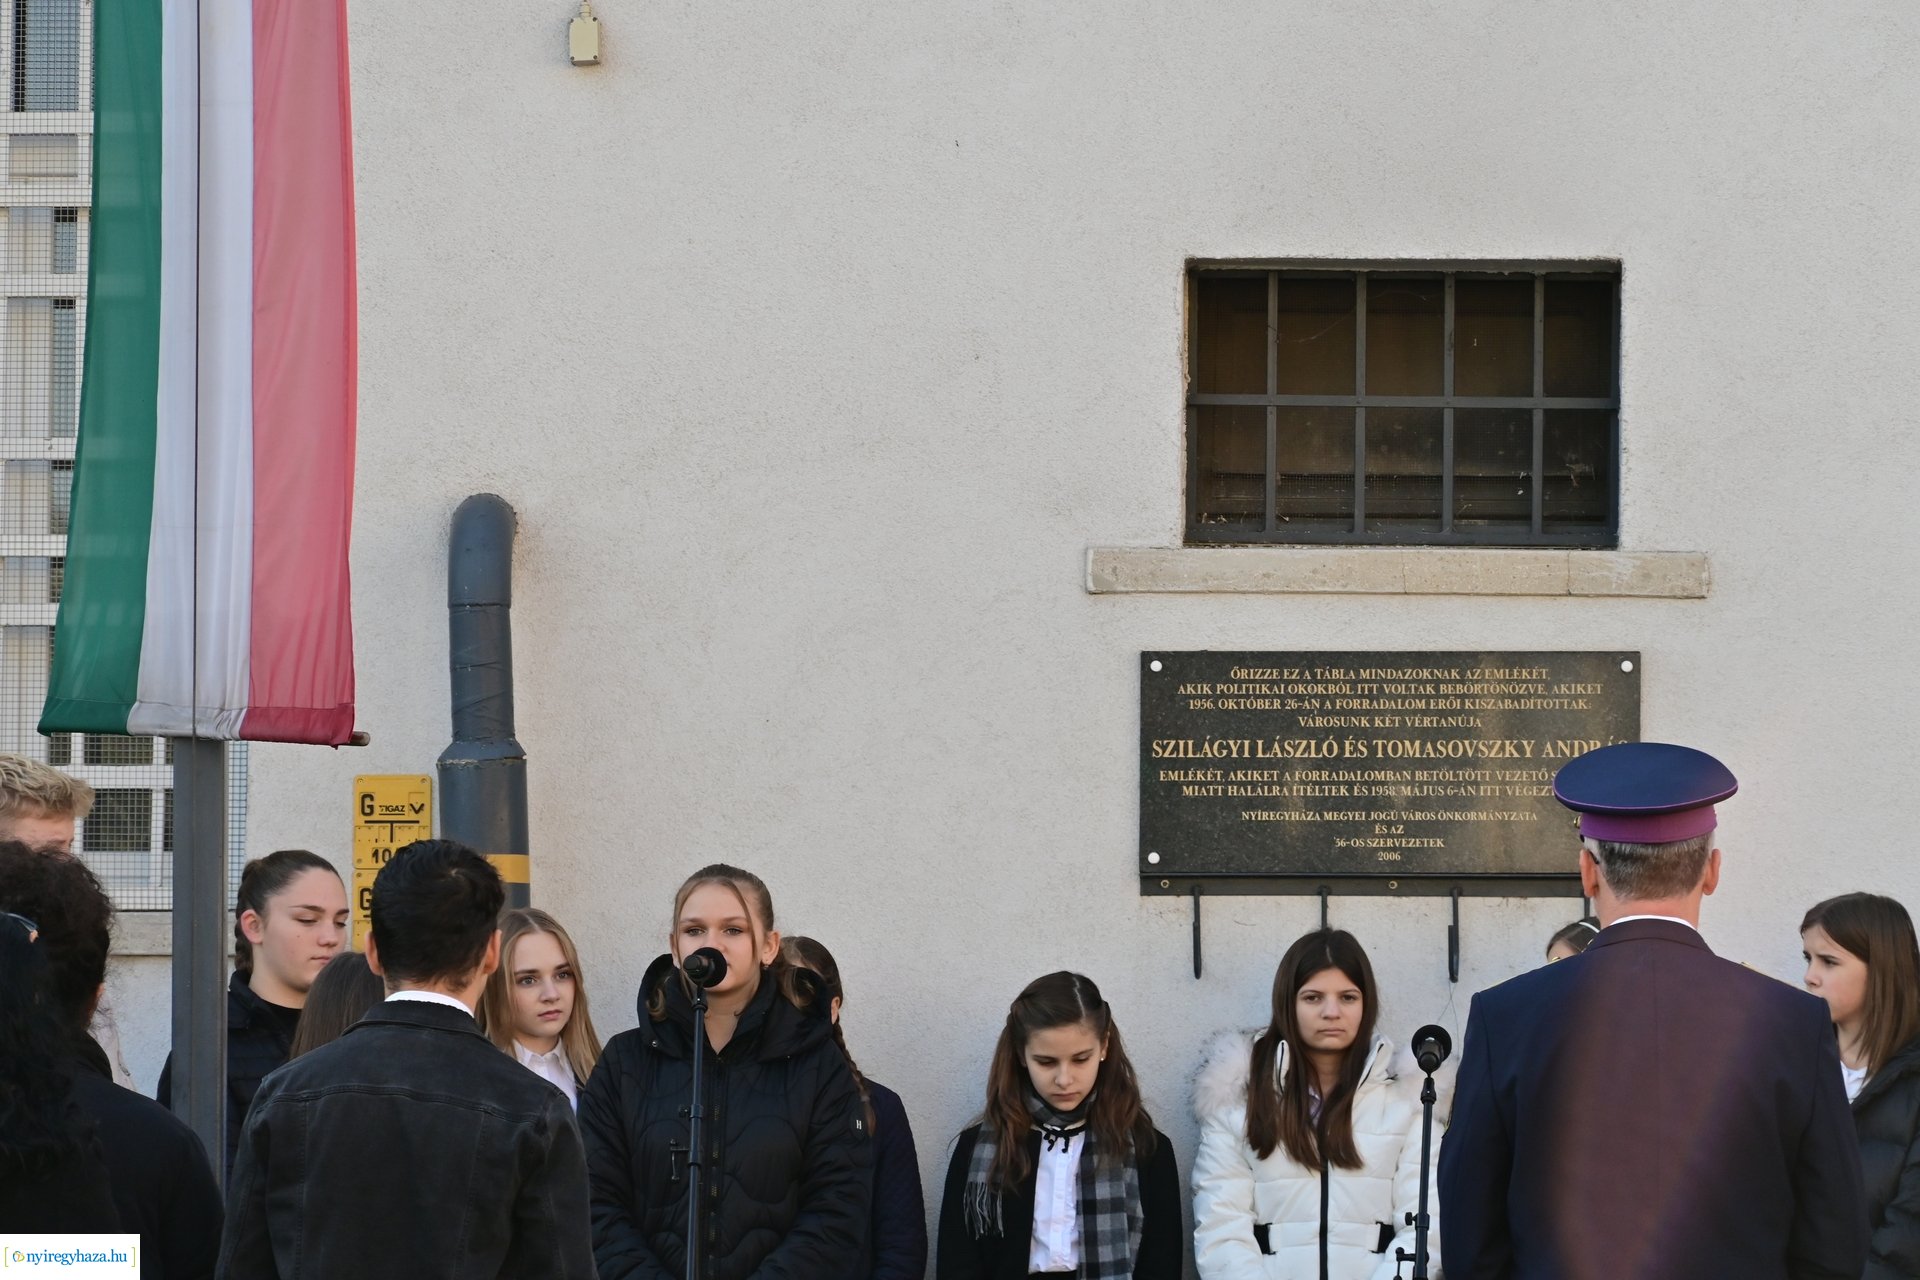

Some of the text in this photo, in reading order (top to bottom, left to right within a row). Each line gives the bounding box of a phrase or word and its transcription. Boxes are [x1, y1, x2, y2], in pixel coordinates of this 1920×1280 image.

[1230, 666, 1281, 680] ŐRIZZE
[1283, 668, 1300, 680] EZ
[1303, 669, 1312, 680] A
[1314, 666, 1356, 680] TÁBLA
[1359, 668, 1461, 680] MINDAZOKNAK
[1464, 668, 1482, 680] AZ
[1177, 683, 1212, 695] AKIK
[1216, 683, 1285, 695] POLITIKAI
[1287, 681, 1354, 695] OKOKBÓL
[1357, 683, 1379, 695] ITT
[1383, 683, 1436, 695] VOLTAK
[1552, 683, 1604, 695] AKIKET
[1189, 699, 1216, 710] 1956.
[1218, 696, 1281, 710] OKTÓBER
[1284, 696, 1320, 710] 26-ÁN
[1324, 699, 1332, 710] A
[1335, 698, 1426, 710] FORRADALOM
[1429, 696, 1461, 710] ERŐI
[1298, 714, 1482, 728] VÁROSUNK KÉT VÉRTANÚJA
[1152, 735, 1628, 758] SZILÁGYI LÁSZLÓ ÉS TOMASOVSZKY ANDR
[1228, 770, 1280, 781] AKIKET
[1283, 772, 1291, 781] A
[1295, 770, 1411, 782] FORRADALOMBAN
[1415, 768, 1492, 782] BETÖLTÖTT
[1496, 768, 1549, 782] VEZETŐ
[1182, 785, 1224, 796] MIATT
[1227, 783, 1289, 796] HALÁLRA
[1292, 783, 1350, 796] ÍTÉLTEK
[1353, 783, 1369, 796] ÉS
[1401, 783, 1444, 796] MÁJUS
[1447, 783, 1476, 796] 6-ÁN
[1479, 785, 1501, 796] ITT
[361, 793, 374, 816] G
[1241, 810, 1538, 821] NYÍREGYHÁZA MEGYEI JOGÚ VÁROS ÖNKORMÁNYZATA
[1374, 823, 1404, 834] ÉS AZ
[1366, 838, 1445, 848] SZERVEZETEK
[1377, 851, 1401, 861] 2006
